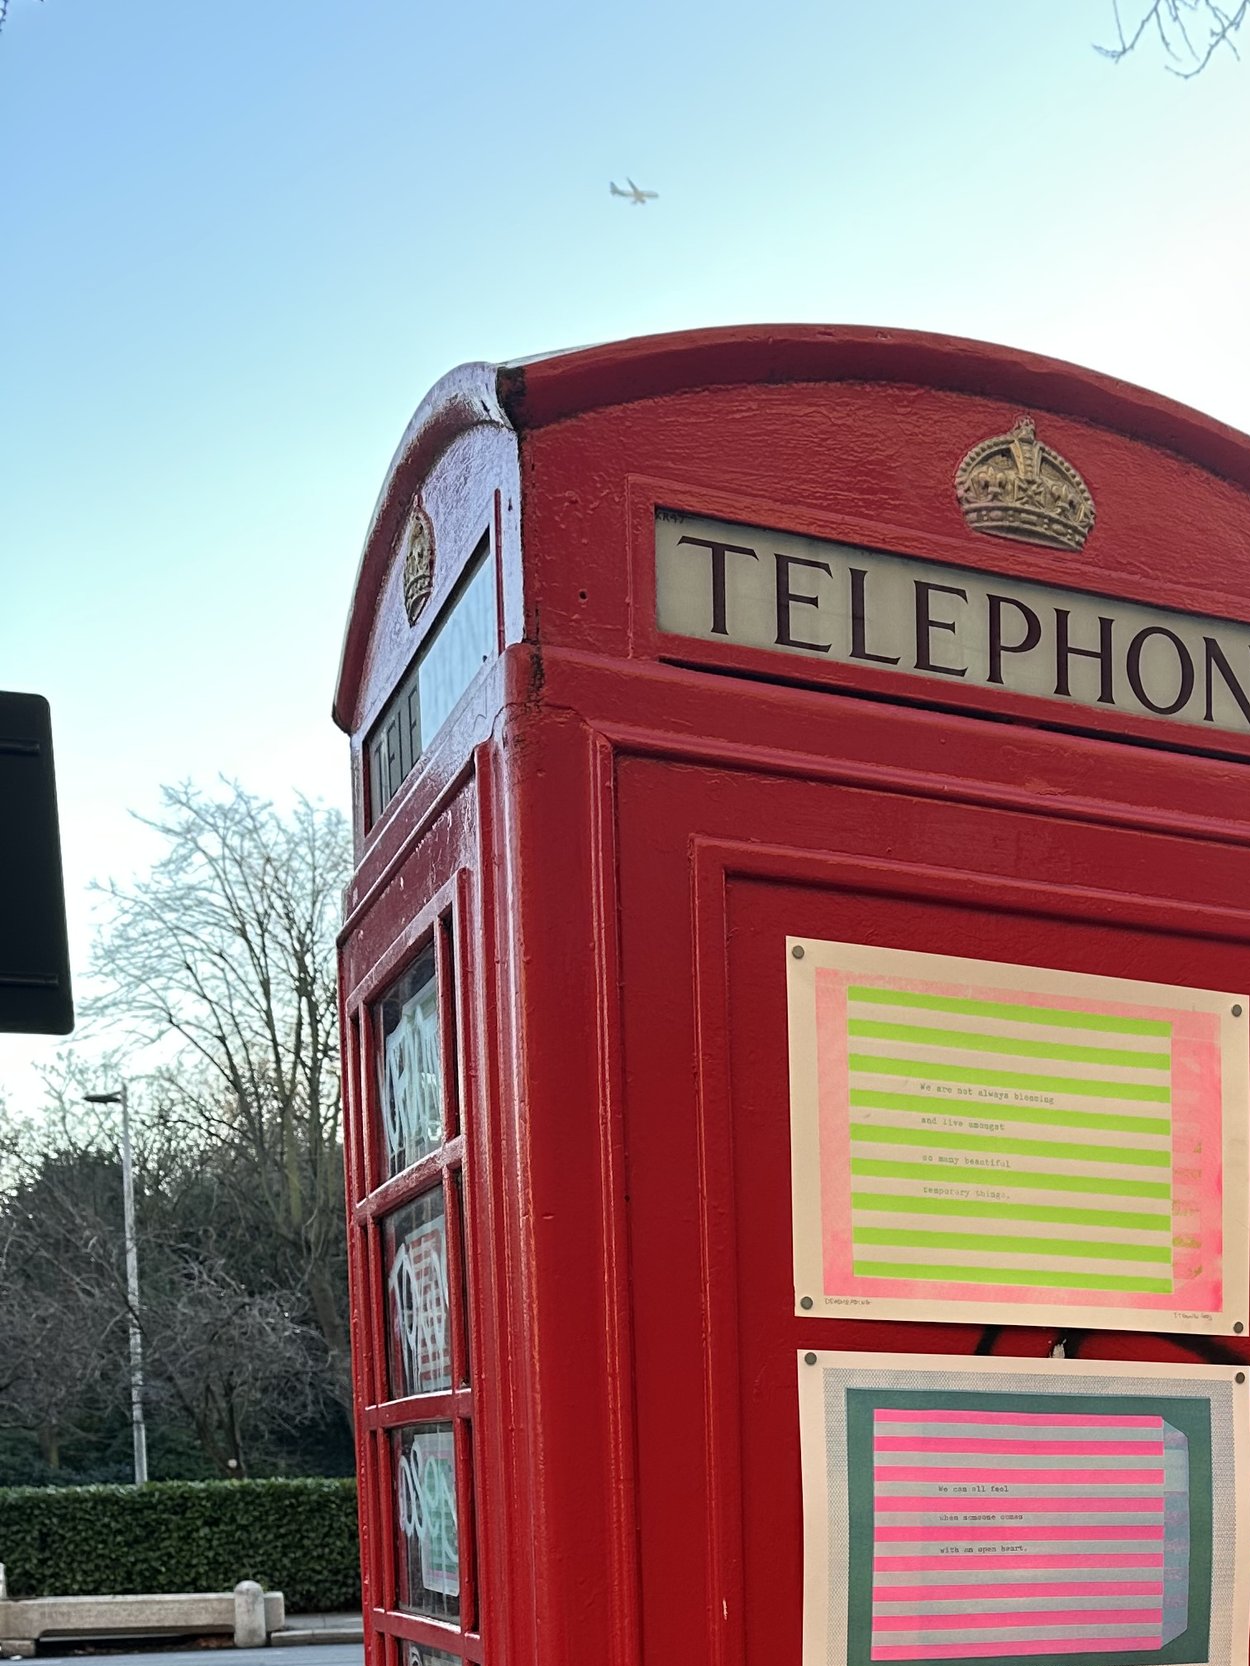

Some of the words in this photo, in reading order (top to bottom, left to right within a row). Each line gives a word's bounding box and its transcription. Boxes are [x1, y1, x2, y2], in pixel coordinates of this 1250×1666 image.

[920, 1083, 931, 1092] We
[957, 1087, 973, 1096] not
[978, 1089, 1009, 1101] always
[921, 1117, 937, 1125] and
[943, 1118, 963, 1127] live
[938, 1156, 960, 1165] many
[964, 1157, 1012, 1168] beautiful
[923, 1186, 970, 1198] temporary
[975, 1189, 1010, 1200] things.
[940, 1546, 959, 1554] with
[977, 1546, 996, 1554] open
